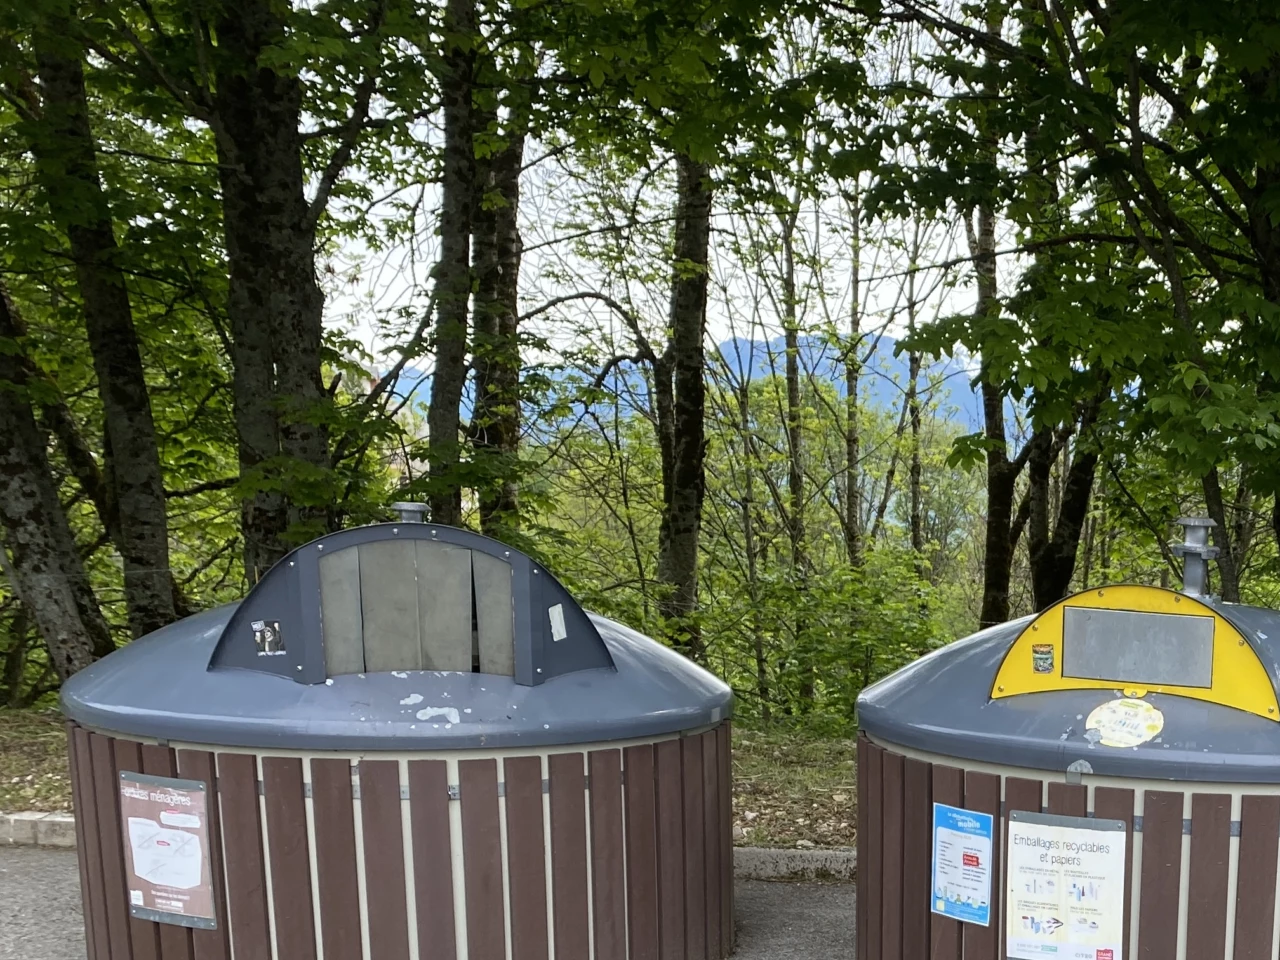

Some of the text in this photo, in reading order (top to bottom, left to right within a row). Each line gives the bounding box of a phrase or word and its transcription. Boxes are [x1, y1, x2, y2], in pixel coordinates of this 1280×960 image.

[150, 790, 191, 806] ménagères
[1013, 834, 1110, 854] Emballages recyclables
[1040, 853, 1081, 867] et papiers
